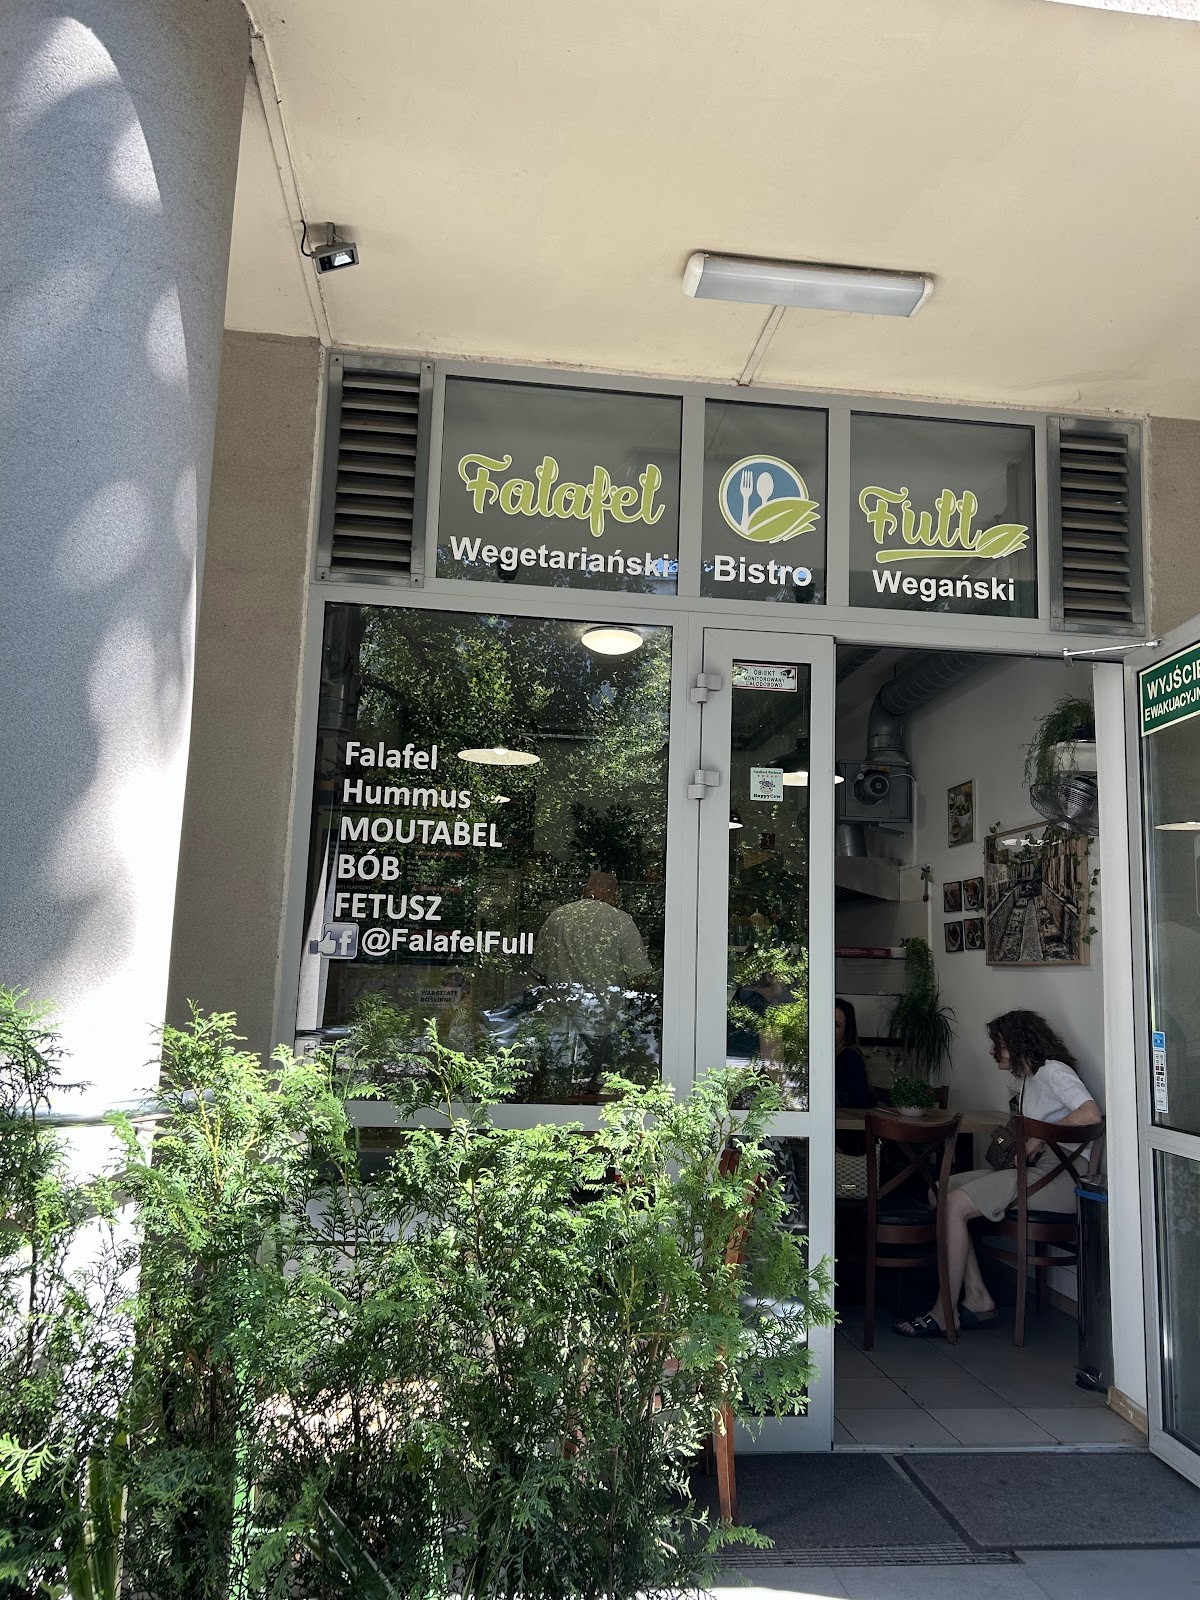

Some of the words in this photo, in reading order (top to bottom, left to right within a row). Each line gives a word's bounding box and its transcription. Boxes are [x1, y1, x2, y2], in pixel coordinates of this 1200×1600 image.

[457, 453, 666, 538] Falafel
[858, 485, 983, 550] Full
[450, 535, 671, 578] Wegetariański
[713, 554, 813, 587] Bistro
[872, 568, 1015, 602] Wegański
[753, 669, 776, 677] OBIEKT
[345, 741, 438, 770] Falafel
[342, 779, 472, 809] Hummus
[340, 816, 503, 848] MOUTABEL
[337, 849, 400, 881] BÓB
[334, 891, 442, 922] FETUSZ
[361, 927, 534, 957] @FalafelFull
